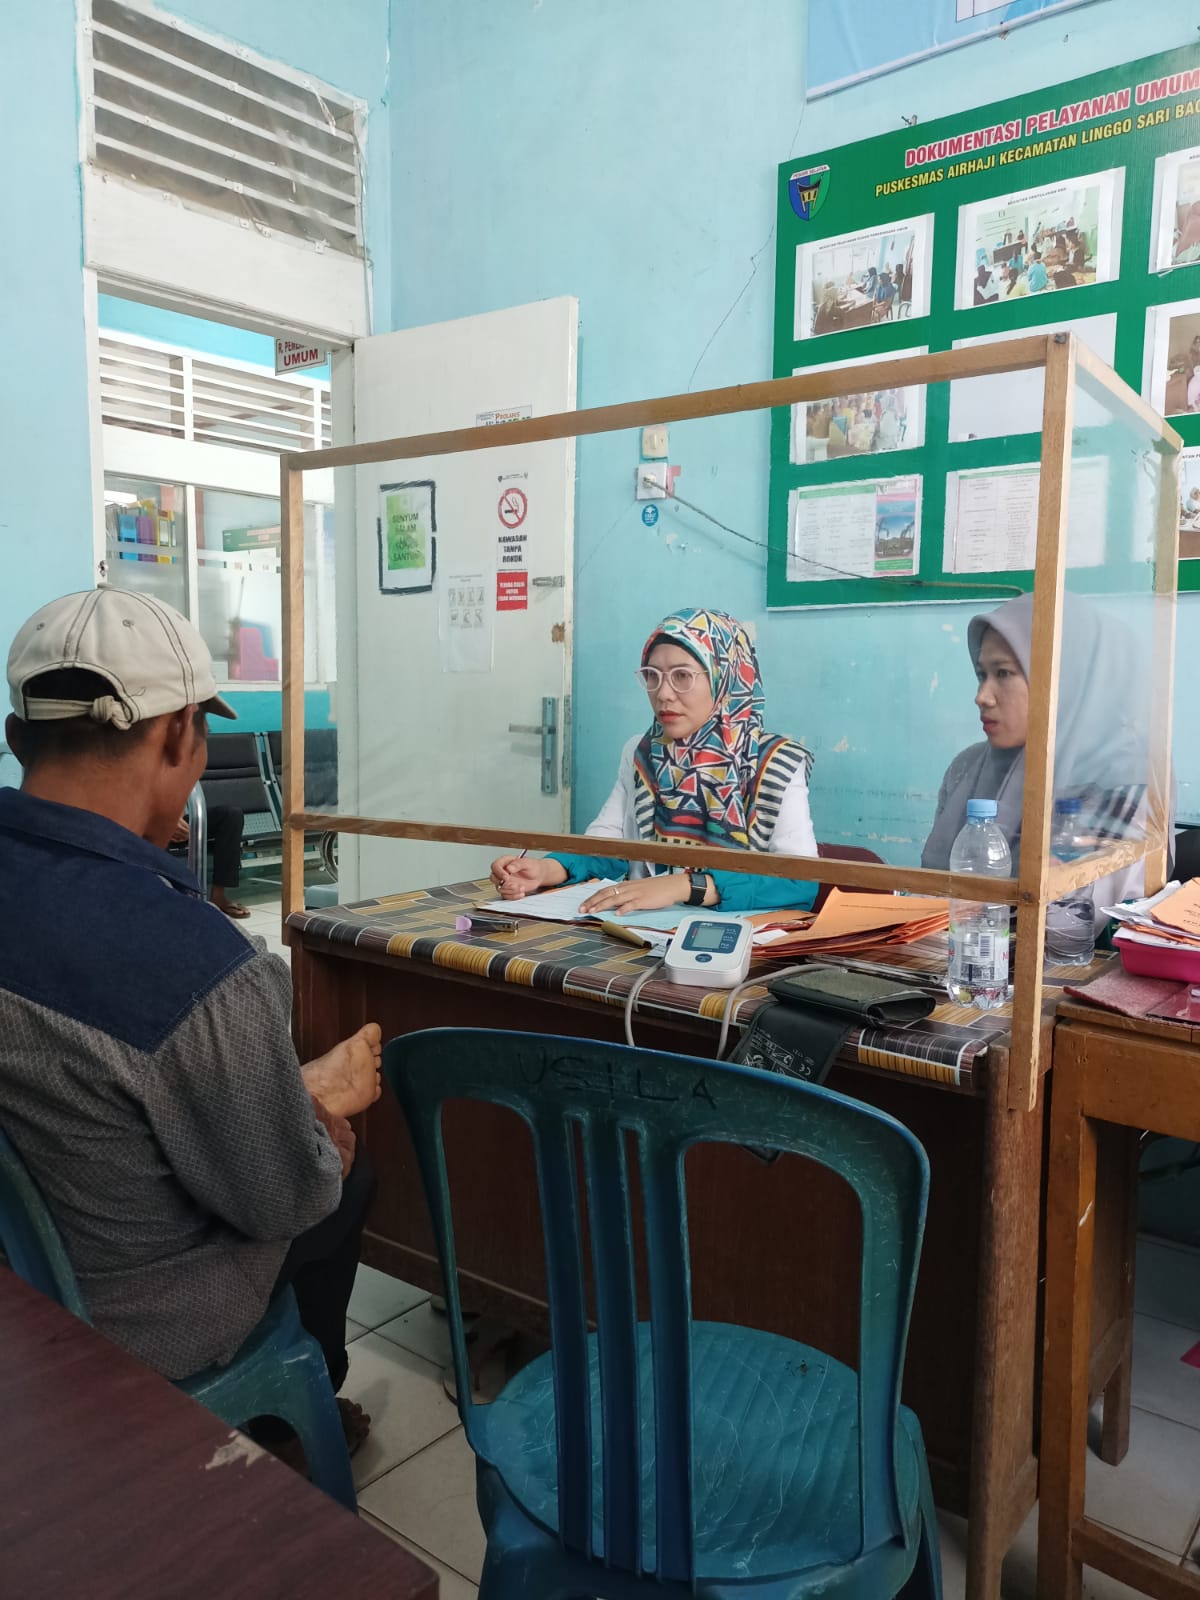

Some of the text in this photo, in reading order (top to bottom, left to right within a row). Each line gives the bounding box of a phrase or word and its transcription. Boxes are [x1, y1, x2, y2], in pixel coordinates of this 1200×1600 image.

[904, 68, 1200, 168] DOKUMENTASI PELAYANAN UMUM
[875, 169, 944, 197] PUSKESMAS
[947, 154, 996, 178] AIRHAJI
[999, 133, 1078, 166] KECAMATAN
[1081, 118, 1133, 145] LINGGO
[1136, 107, 1171, 130] SARI
[283, 348, 318, 367] UMUM
[503, 545, 522, 553] TANPA
